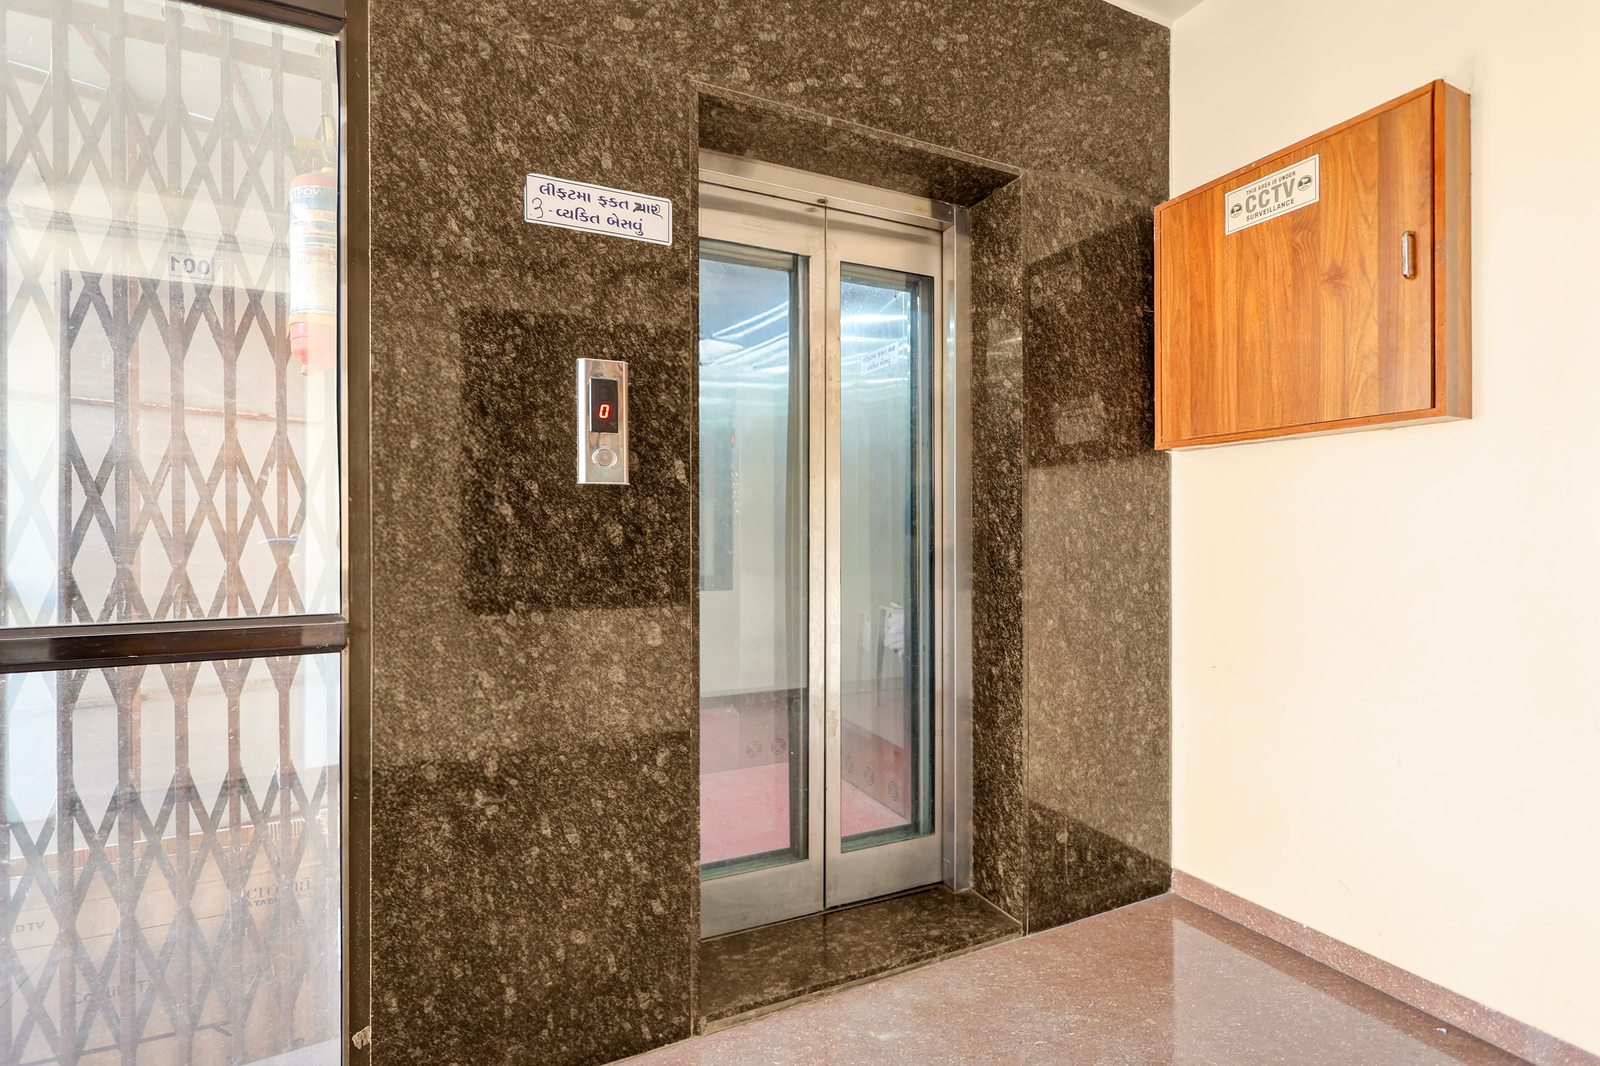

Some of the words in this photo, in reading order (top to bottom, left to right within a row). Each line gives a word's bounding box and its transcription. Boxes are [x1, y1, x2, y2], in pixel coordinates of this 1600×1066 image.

[1246, 187, 1257, 195] THIS
[1258, 181, 1271, 191] AREA
[1278, 170, 1296, 182] UNDER
[597, 195, 629, 210] ફકત
[1245, 177, 1296, 214] CCTV
[1246, 197, 1295, 222] SURVEILLANCE
[606, 212, 644, 236] બેસવું
[599, 403, 610, 419] 0
[254, 897, 278, 907] TATA
[27, 920, 45, 931] TV
